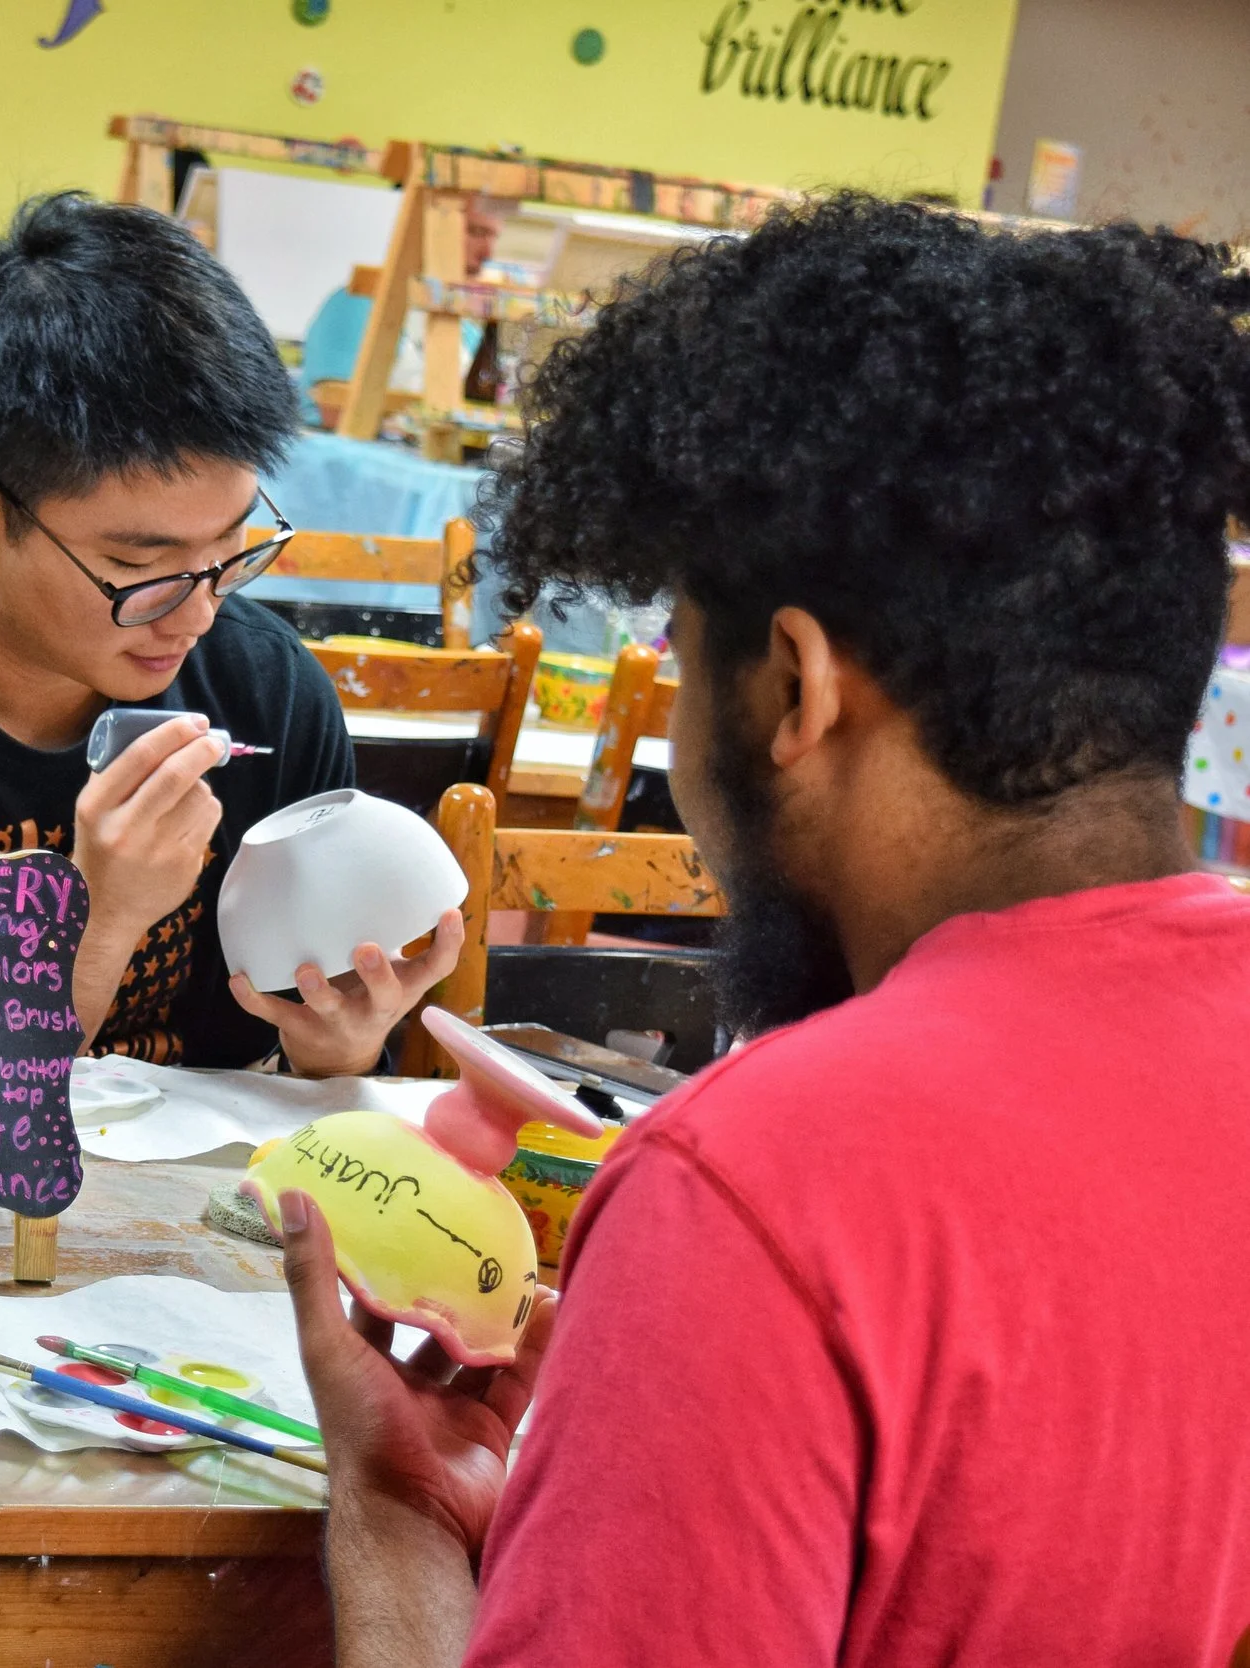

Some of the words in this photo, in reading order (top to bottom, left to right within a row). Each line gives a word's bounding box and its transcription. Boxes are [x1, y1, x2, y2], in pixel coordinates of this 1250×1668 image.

[699, 0, 952, 121] brilliance
[3, 998, 81, 1033] Brush
[2, 1082, 44, 1110] top
